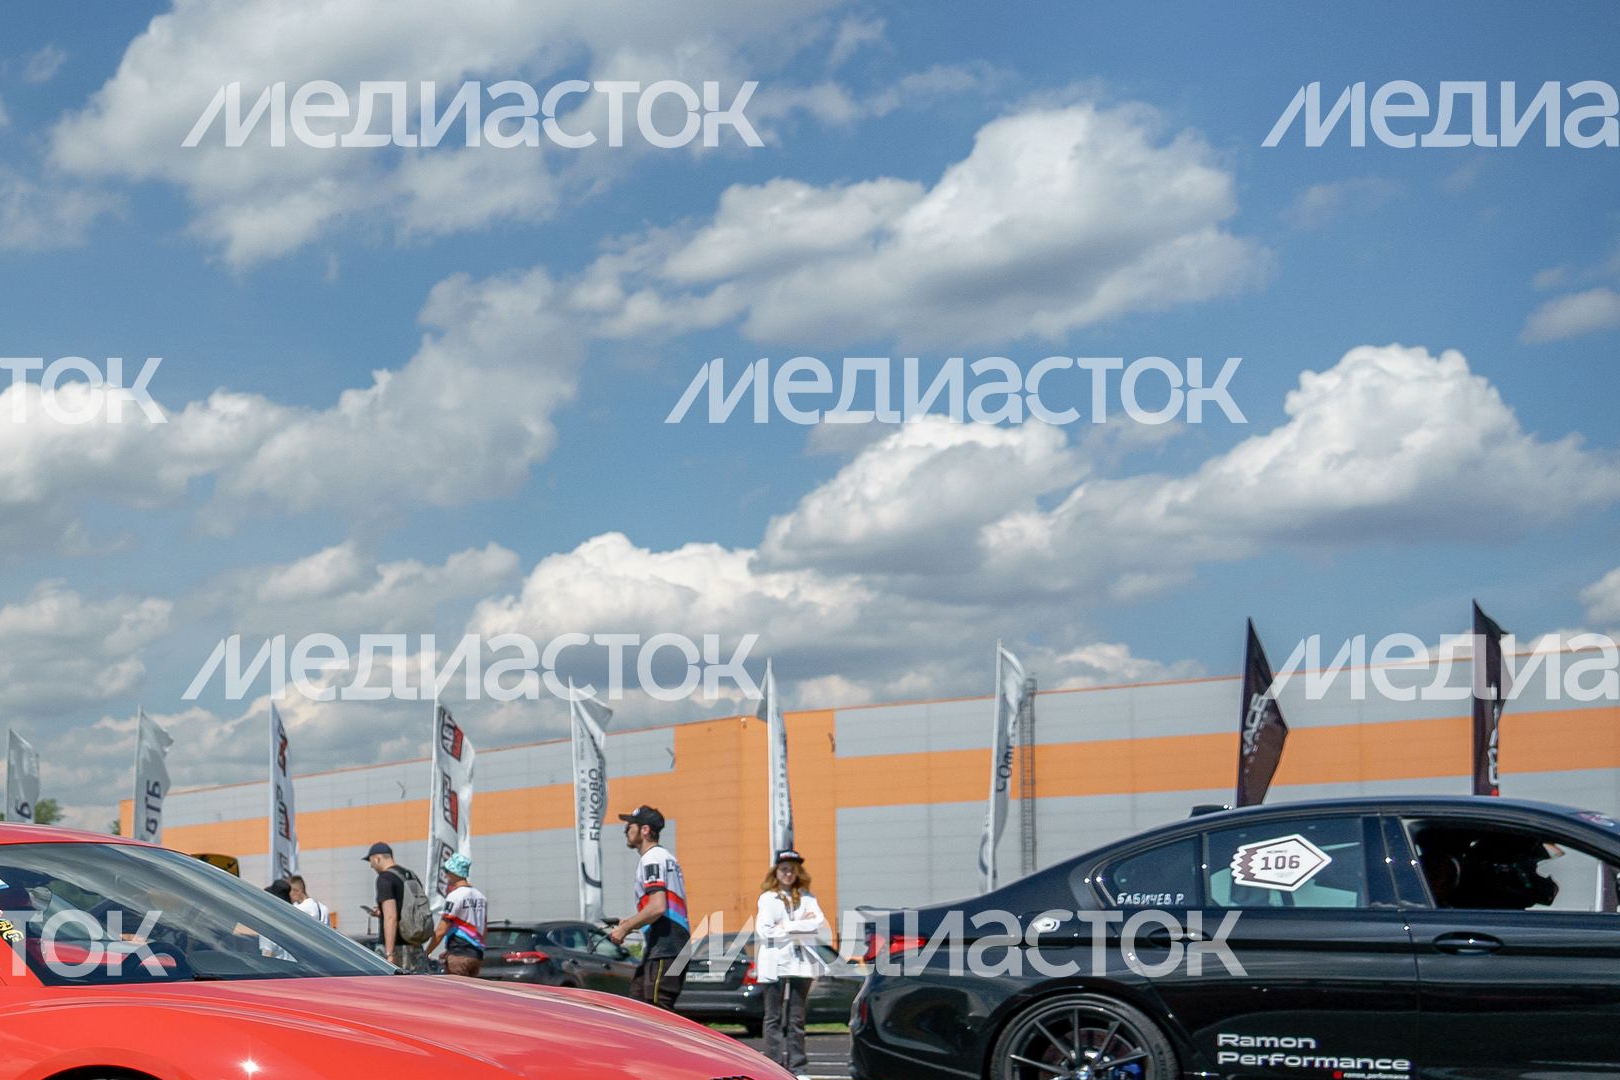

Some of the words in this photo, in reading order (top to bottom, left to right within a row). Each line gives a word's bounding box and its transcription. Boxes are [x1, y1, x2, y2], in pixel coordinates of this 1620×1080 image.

[145, 779, 162, 836] ВТБ
[1261, 855, 1300, 870] 106
[1217, 1033, 1316, 1049] Ramon
[1217, 1052, 1411, 1070] Performance
